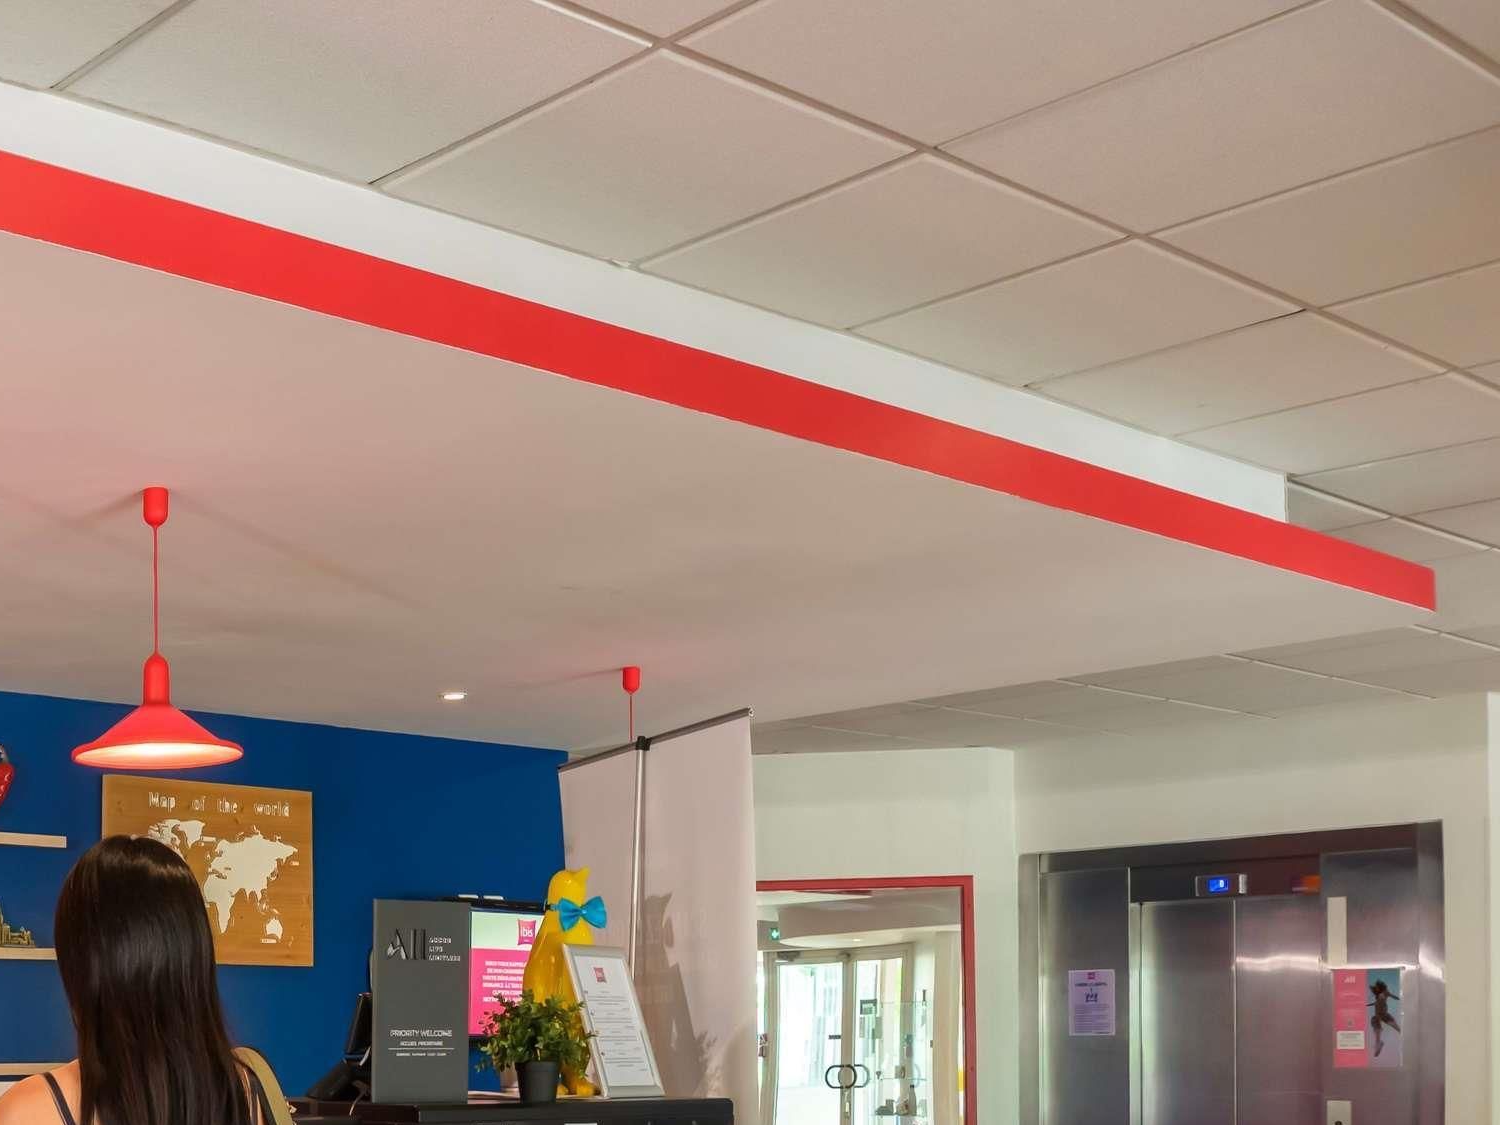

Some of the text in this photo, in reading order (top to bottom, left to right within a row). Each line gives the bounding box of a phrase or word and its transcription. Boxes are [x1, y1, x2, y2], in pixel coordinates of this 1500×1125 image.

[148, 792, 291, 817] Map of the world
[520, 927, 533, 938] ibis
[390, 1029, 453, 1037] PRIORITY WELCOME
